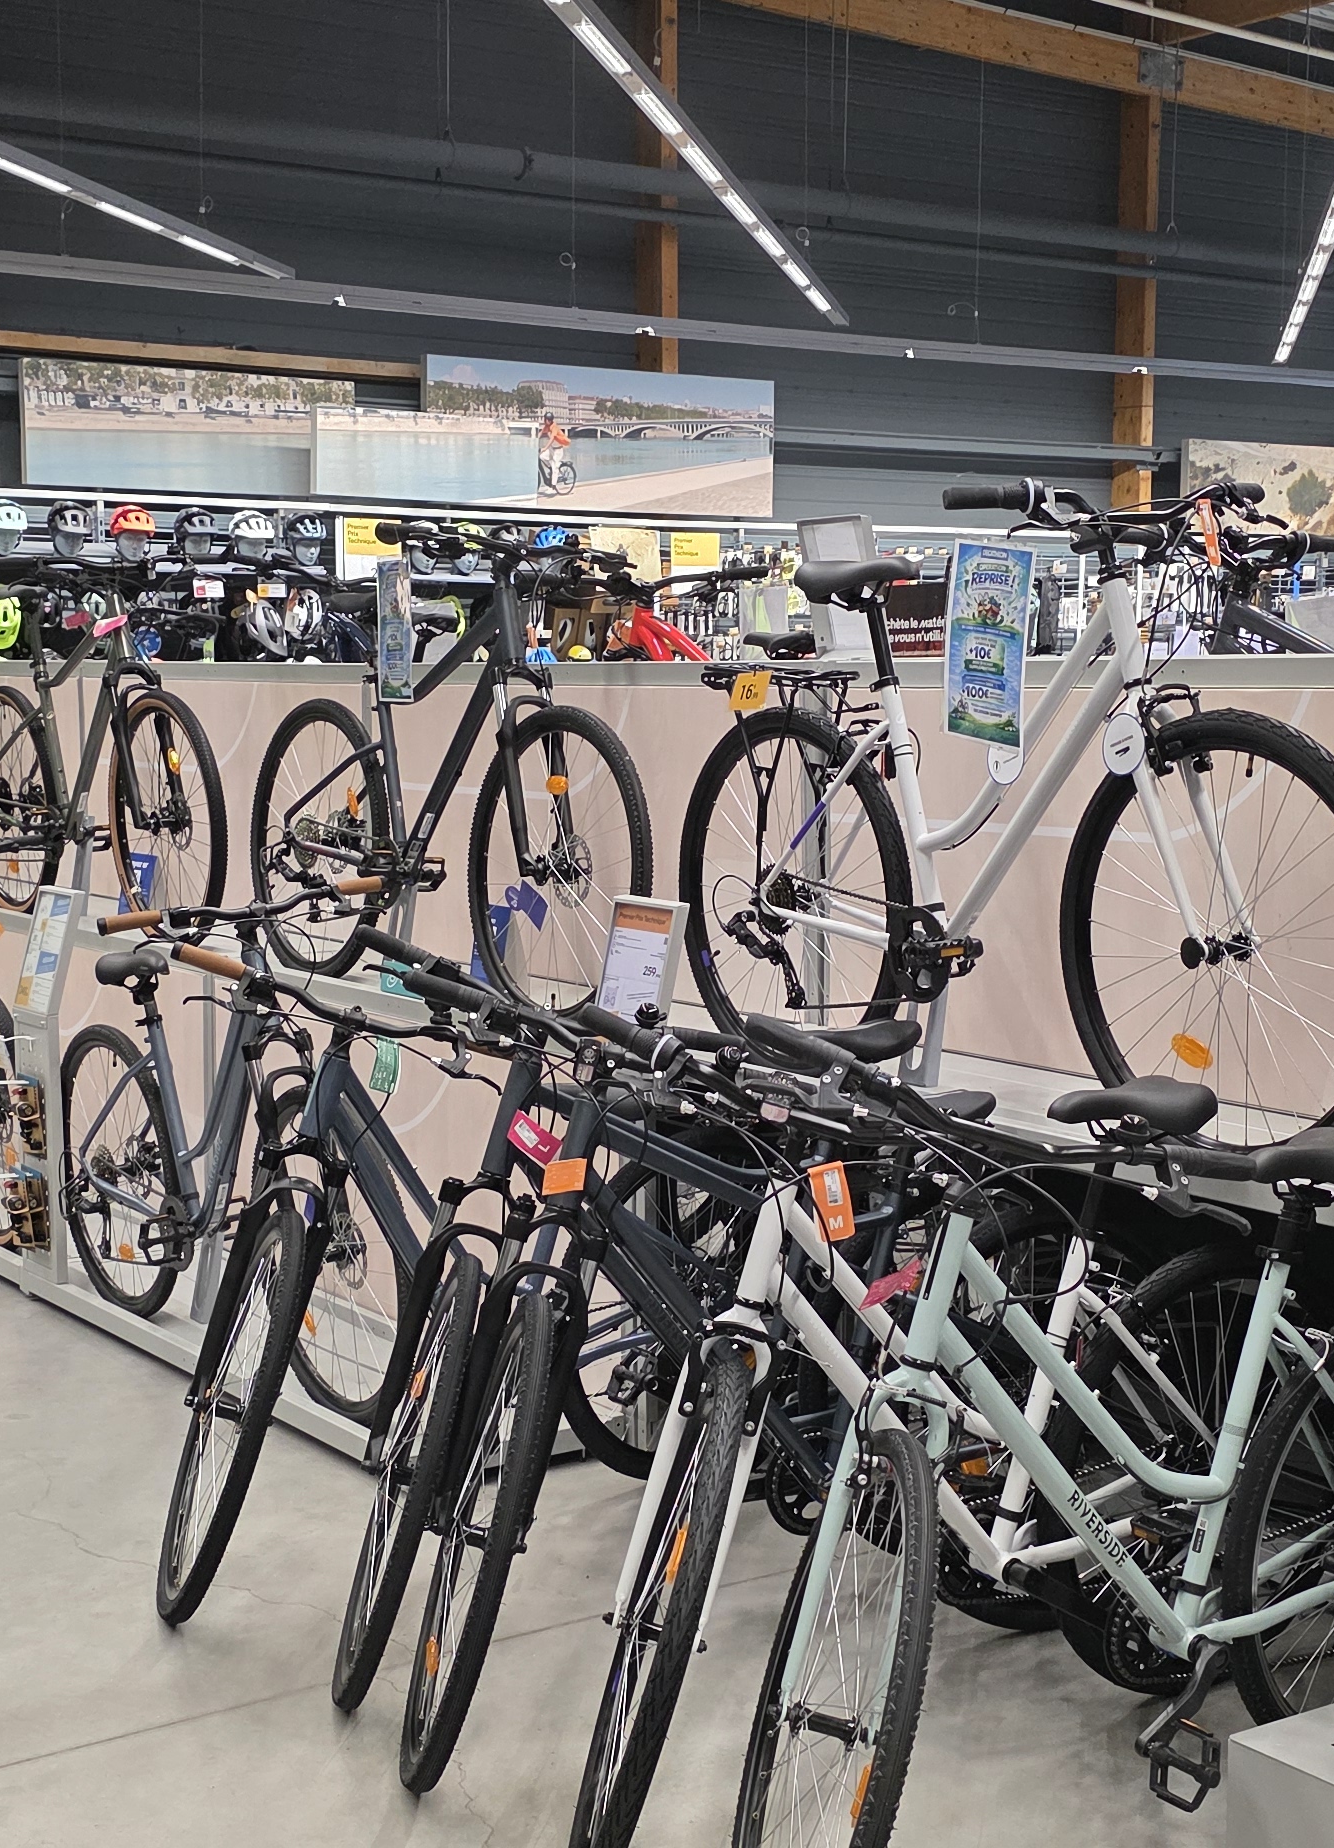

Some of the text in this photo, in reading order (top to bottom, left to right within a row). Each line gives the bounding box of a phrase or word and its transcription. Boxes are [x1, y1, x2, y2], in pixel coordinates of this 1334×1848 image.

[348, 537, 376, 545] Technique
[970, 572, 1011, 586] REPRISE
[887, 615, 944, 629] chète le matér
[895, 633, 916, 643] vous
[916, 629, 944, 642] n'utilis
[968, 645, 992, 660] +10€
[961, 685, 990, 699] +100€
[828, 1214, 844, 1231] M
[1067, 1489, 1130, 1568] RIVERSIDE
